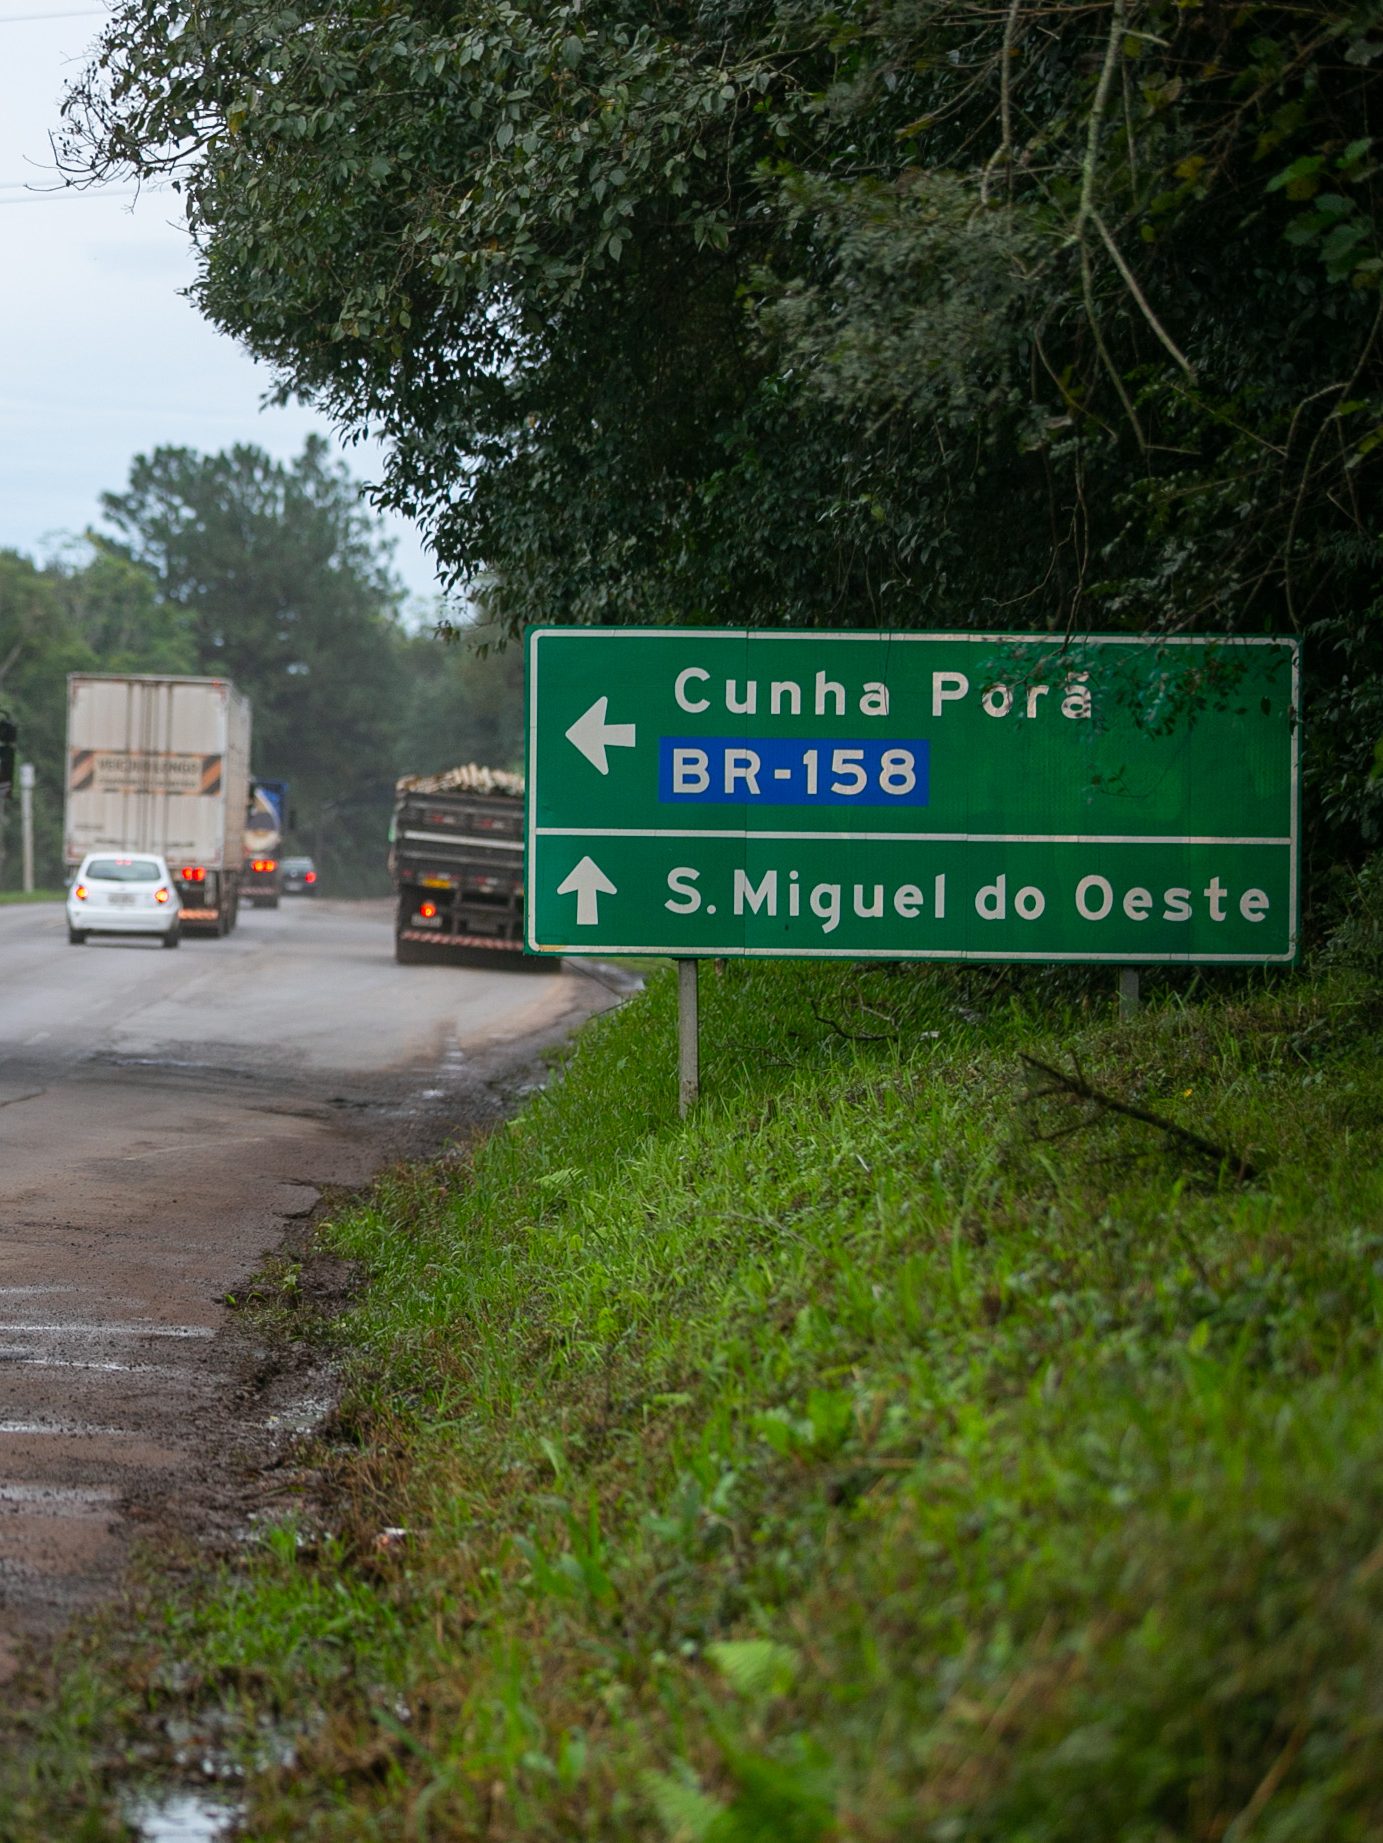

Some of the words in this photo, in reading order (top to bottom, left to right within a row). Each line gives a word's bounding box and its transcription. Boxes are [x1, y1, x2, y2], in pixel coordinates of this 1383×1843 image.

[674, 667, 890, 718] Cunha
[932, 671, 1092, 719] Porã
[672, 748, 917, 797] BR-158
[974, 875, 1046, 920] do
[1075, 875, 1270, 922] Oeste
